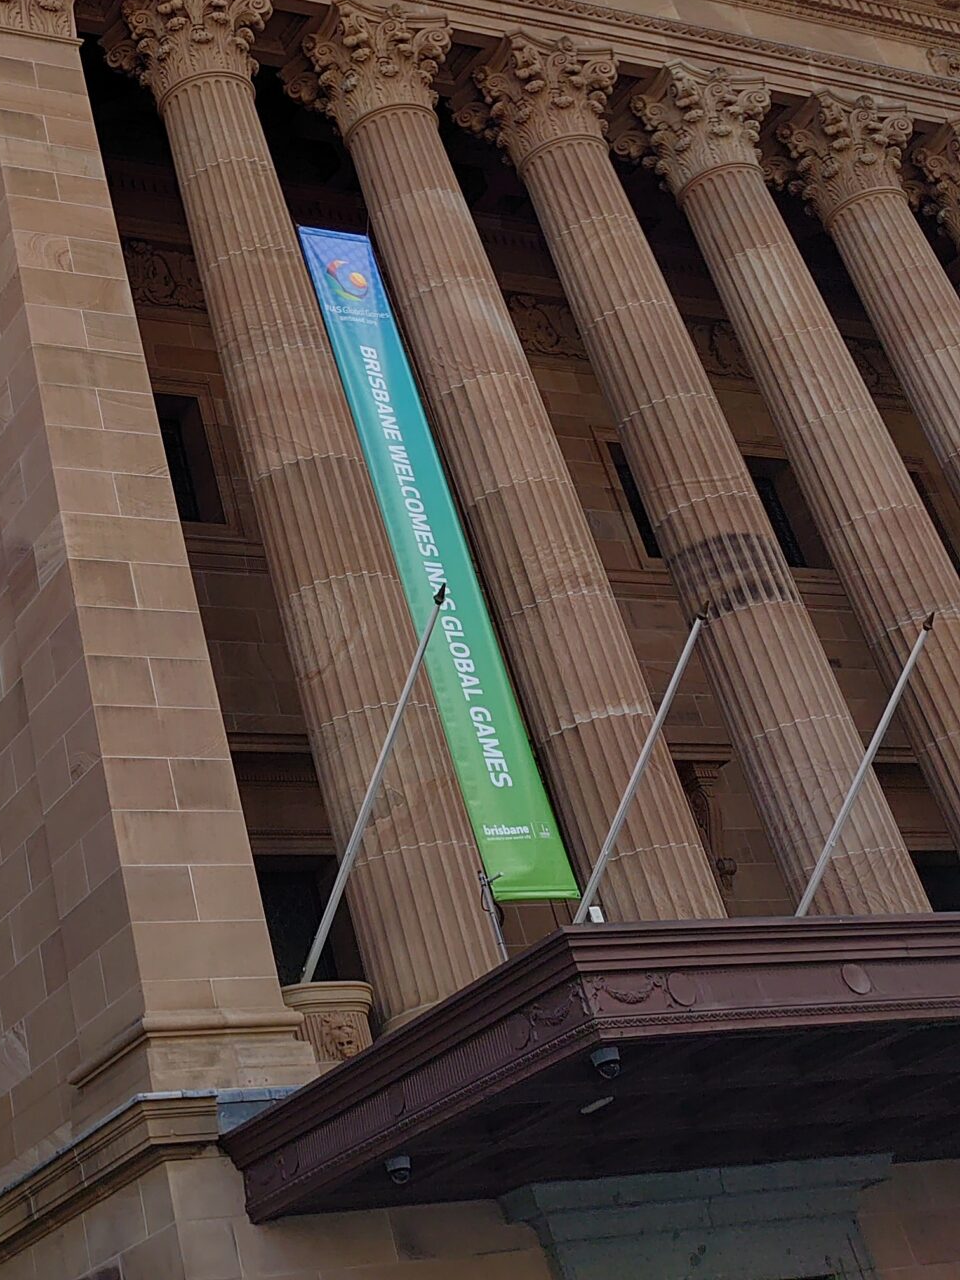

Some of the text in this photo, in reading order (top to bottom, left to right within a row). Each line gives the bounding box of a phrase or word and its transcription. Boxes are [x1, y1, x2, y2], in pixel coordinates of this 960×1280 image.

[359, 345, 402, 441] BRISBANE
[388, 445, 439, 557] WELCOMES
[441, 615, 483, 701] GLOBAL
[469, 706, 513, 788] GAMES
[482, 824, 530, 836] brisbane
